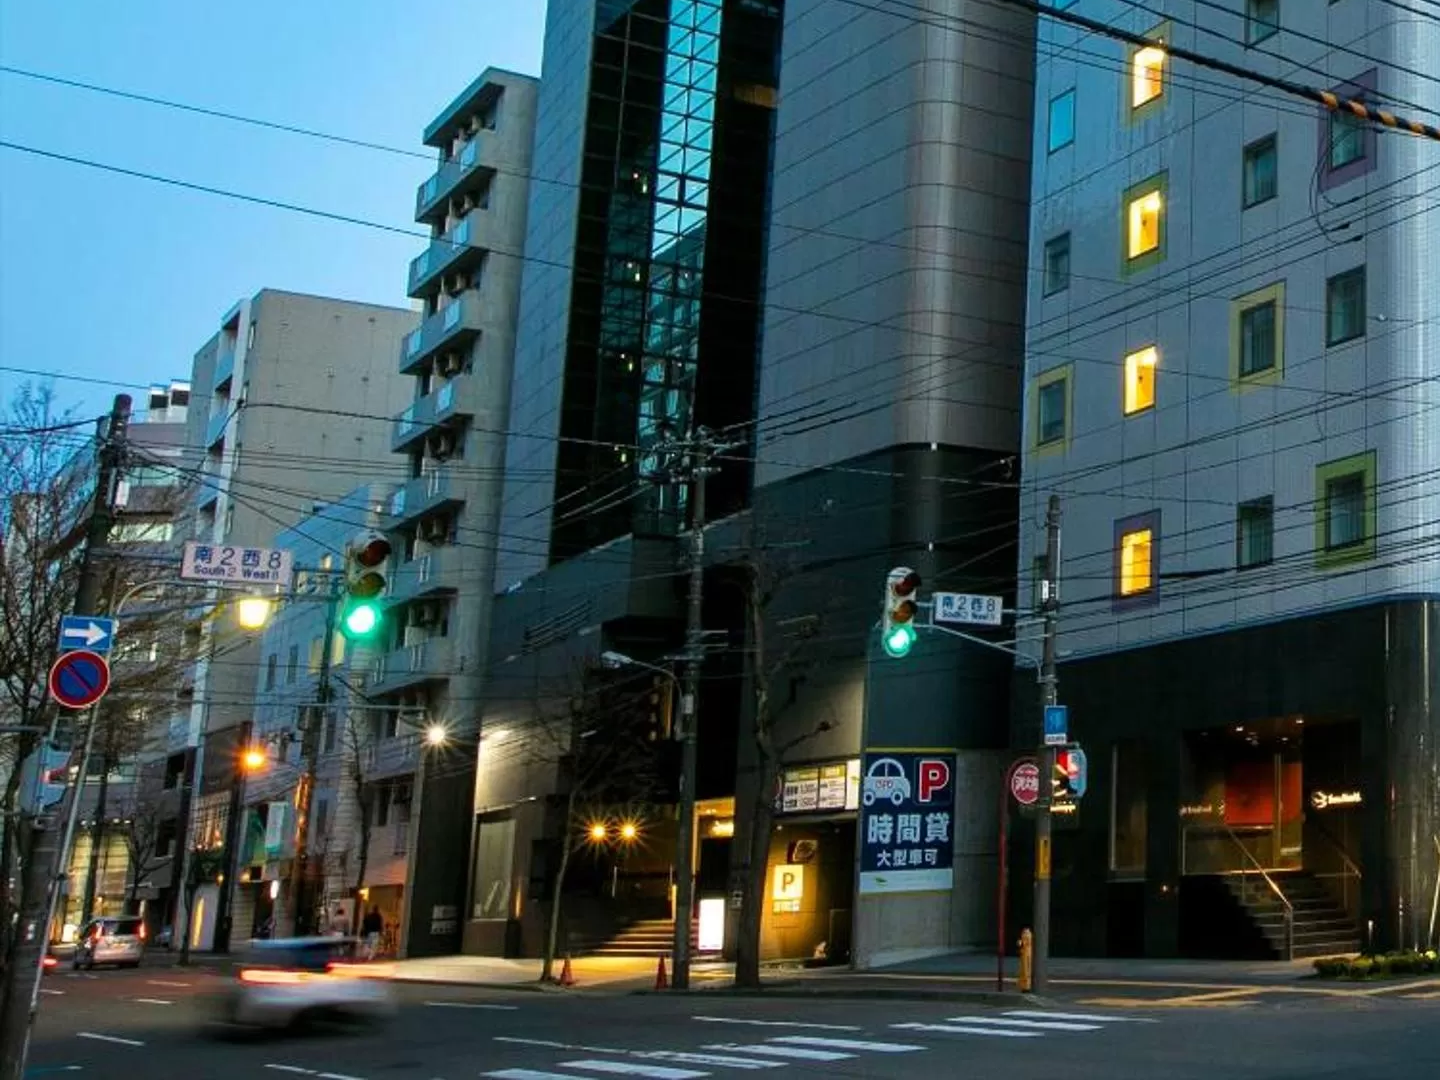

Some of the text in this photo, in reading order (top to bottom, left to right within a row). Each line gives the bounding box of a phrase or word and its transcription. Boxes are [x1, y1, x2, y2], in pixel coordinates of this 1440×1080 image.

[194, 546, 281, 569] 南2西8
[194, 565, 226, 576] South
[242, 568, 270, 579] West
[919, 760, 949, 802] P
[867, 812, 950, 844] 時間貸
[877, 849, 937, 867] 大型車可
[782, 872, 795, 893] P
